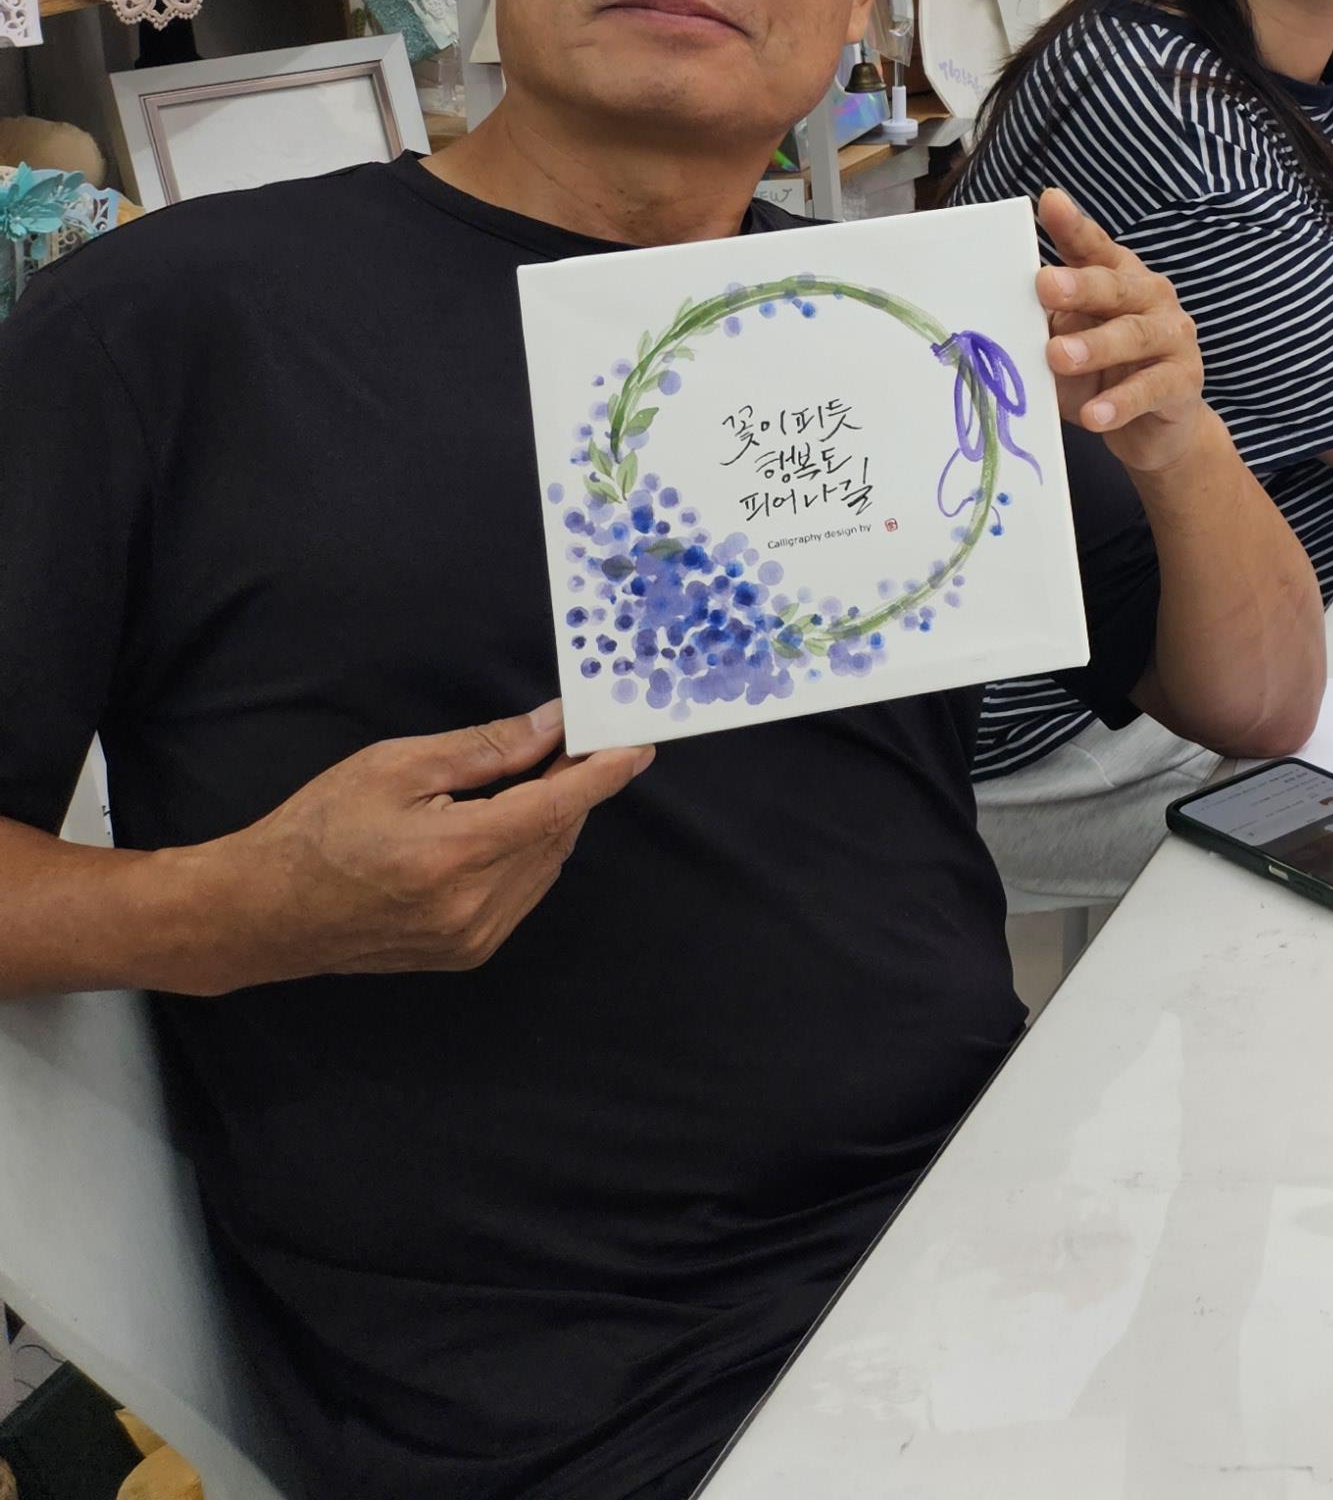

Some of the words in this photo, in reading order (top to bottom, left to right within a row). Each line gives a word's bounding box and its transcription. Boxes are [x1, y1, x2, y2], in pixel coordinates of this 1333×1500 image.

[754, 447, 853, 485] 행복도
[739, 457, 875, 523] 피어나길
[767, 533, 823, 552] Calligraphy
[824, 526, 857, 541] design
[858, 523, 873, 537] by
